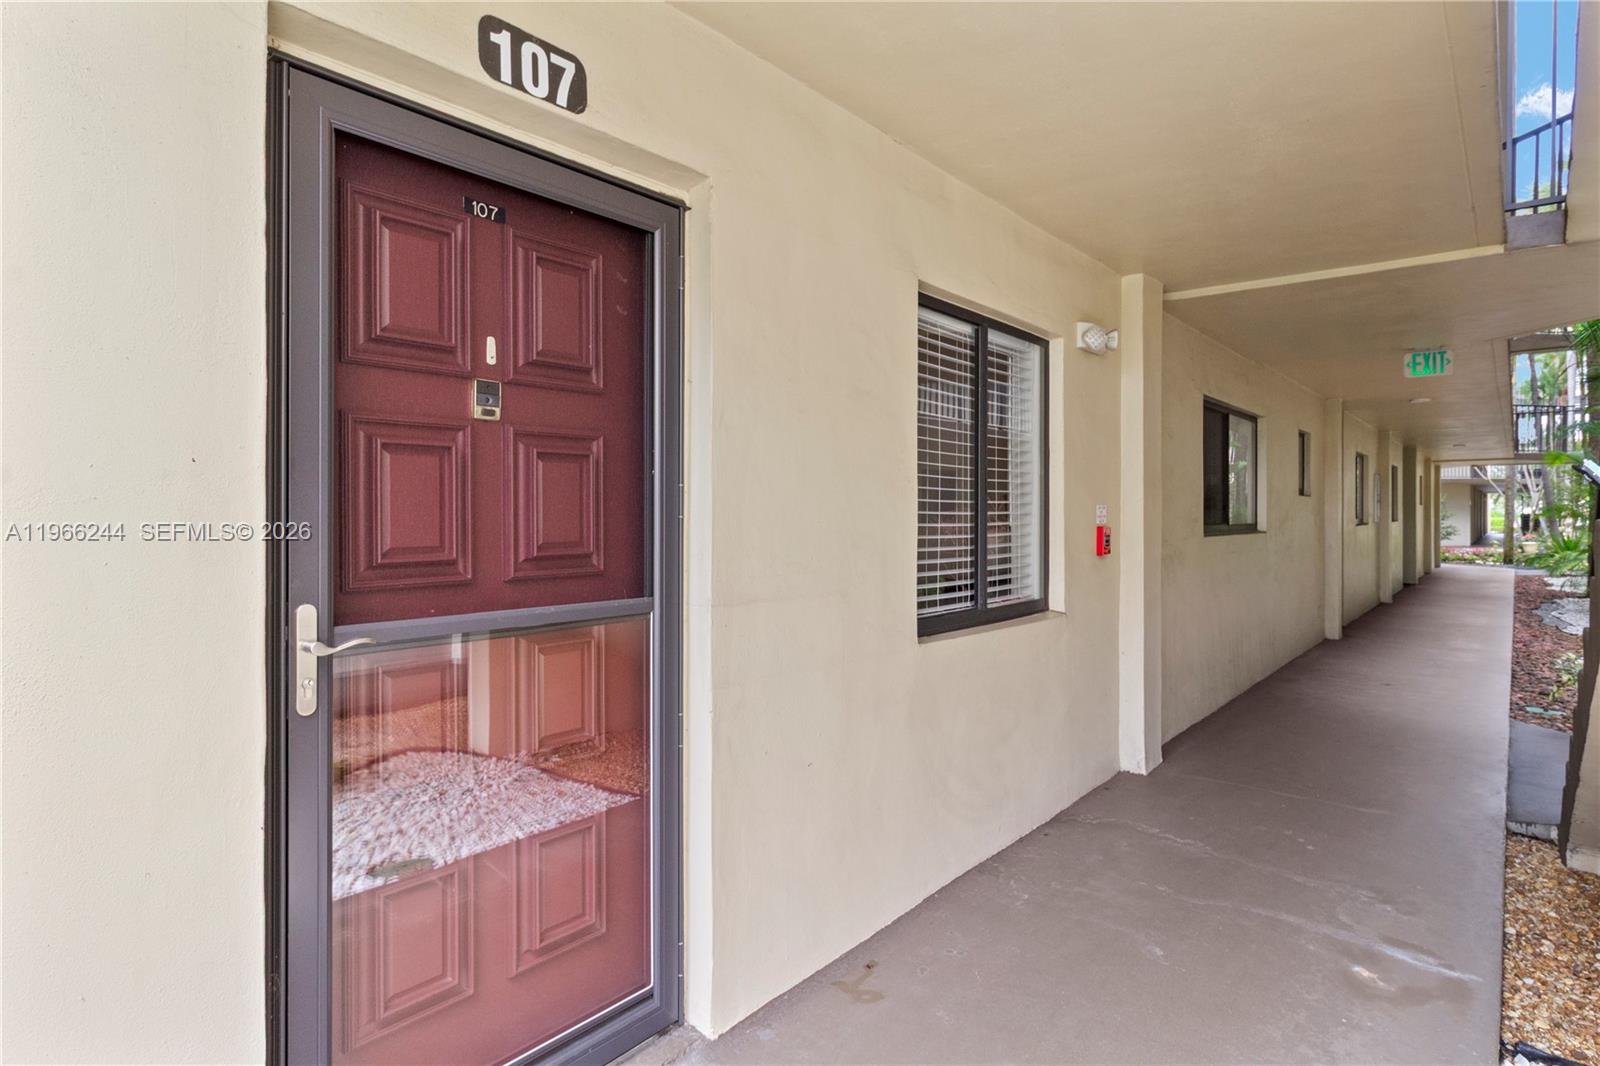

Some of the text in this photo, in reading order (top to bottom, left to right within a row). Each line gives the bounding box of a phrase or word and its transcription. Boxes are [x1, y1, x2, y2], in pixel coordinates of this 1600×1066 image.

[489, 29, 576, 109] 107
[471, 200, 499, 221] 107
[1411, 350, 1447, 377] EXIT
